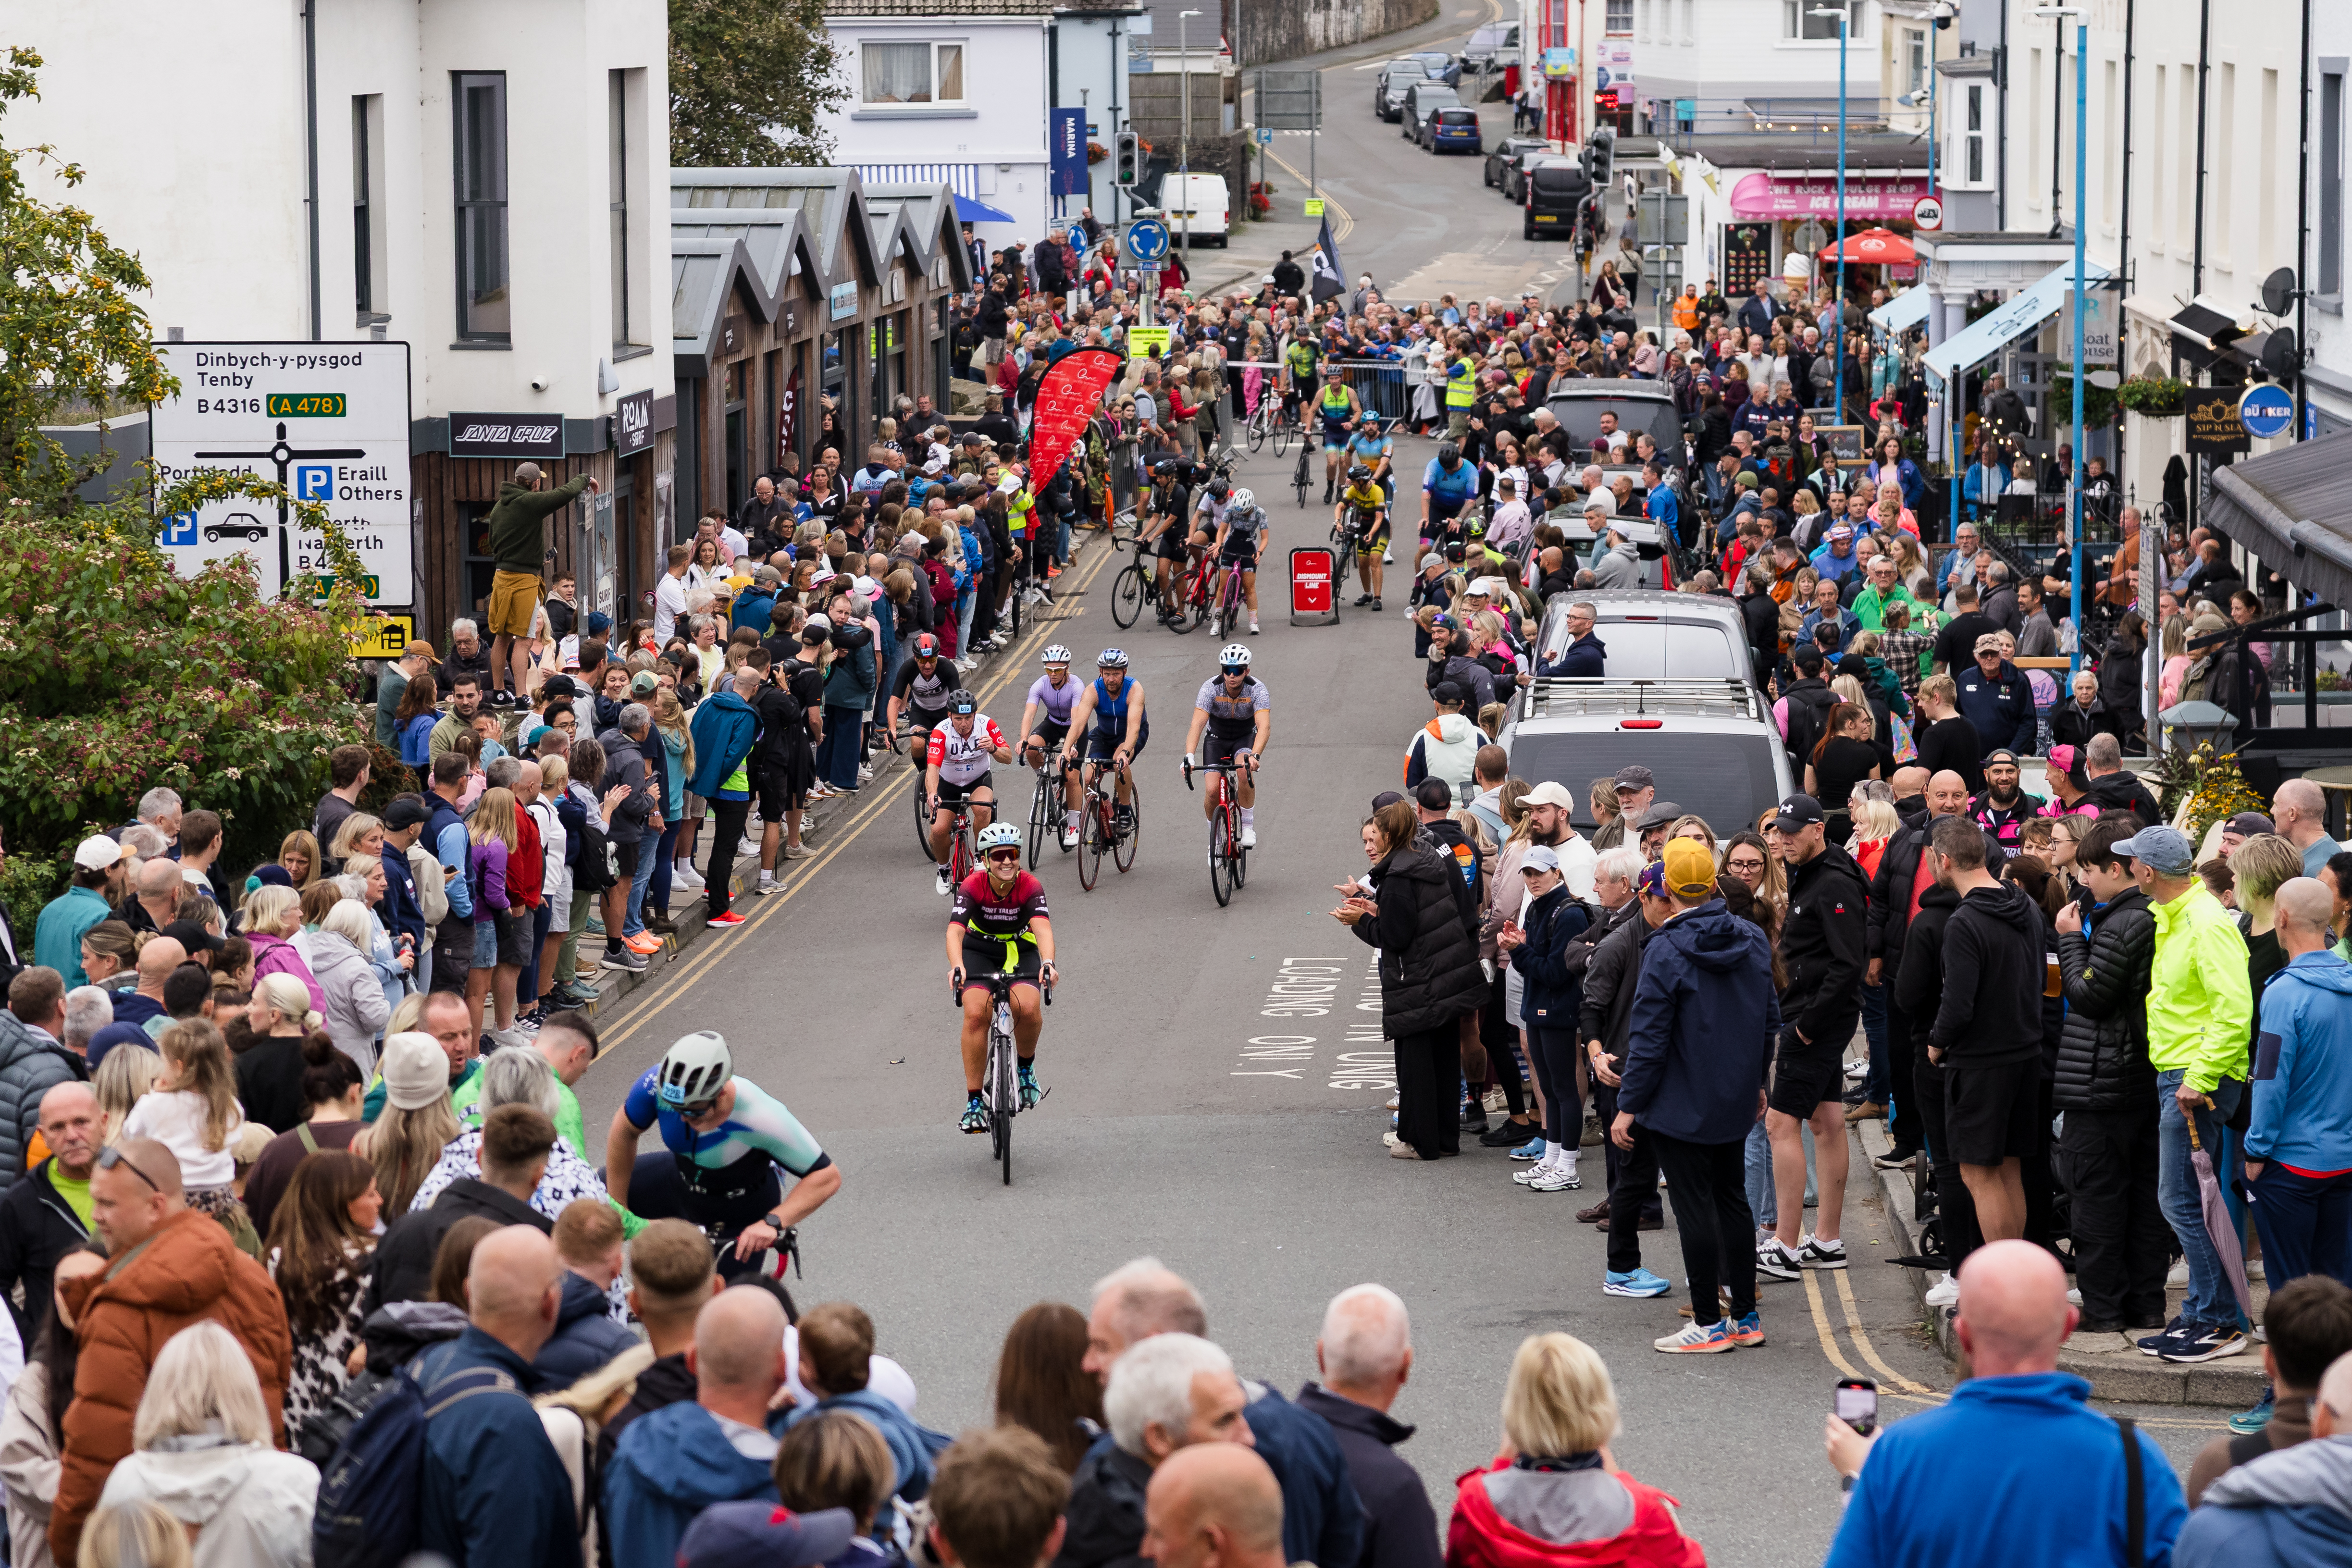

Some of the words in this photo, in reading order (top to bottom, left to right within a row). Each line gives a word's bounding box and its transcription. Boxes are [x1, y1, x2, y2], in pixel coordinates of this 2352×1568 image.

[1066, 117, 1076, 158] MARINA
[1886, 185, 1916, 194] SHOP
[1809, 196, 1830, 209] ICE
[196, 352, 362, 370] Dinbych-y-pysgod
[197, 372, 253, 389] Tenby
[198, 399, 209, 413] B
[213, 398, 260, 413] 4316
[622, 398, 649, 433] ROAM
[455, 425, 511, 442] SANTA
[512, 425, 558, 443] CRUZ
[632, 430, 644, 447] SURF
[338, 466, 387, 481] Eraill
[306, 469, 327, 497] P
[339, 486, 403, 501] Others
[599, 587, 611, 604] SURF
[1260, 957, 1348, 1017] LOADING
